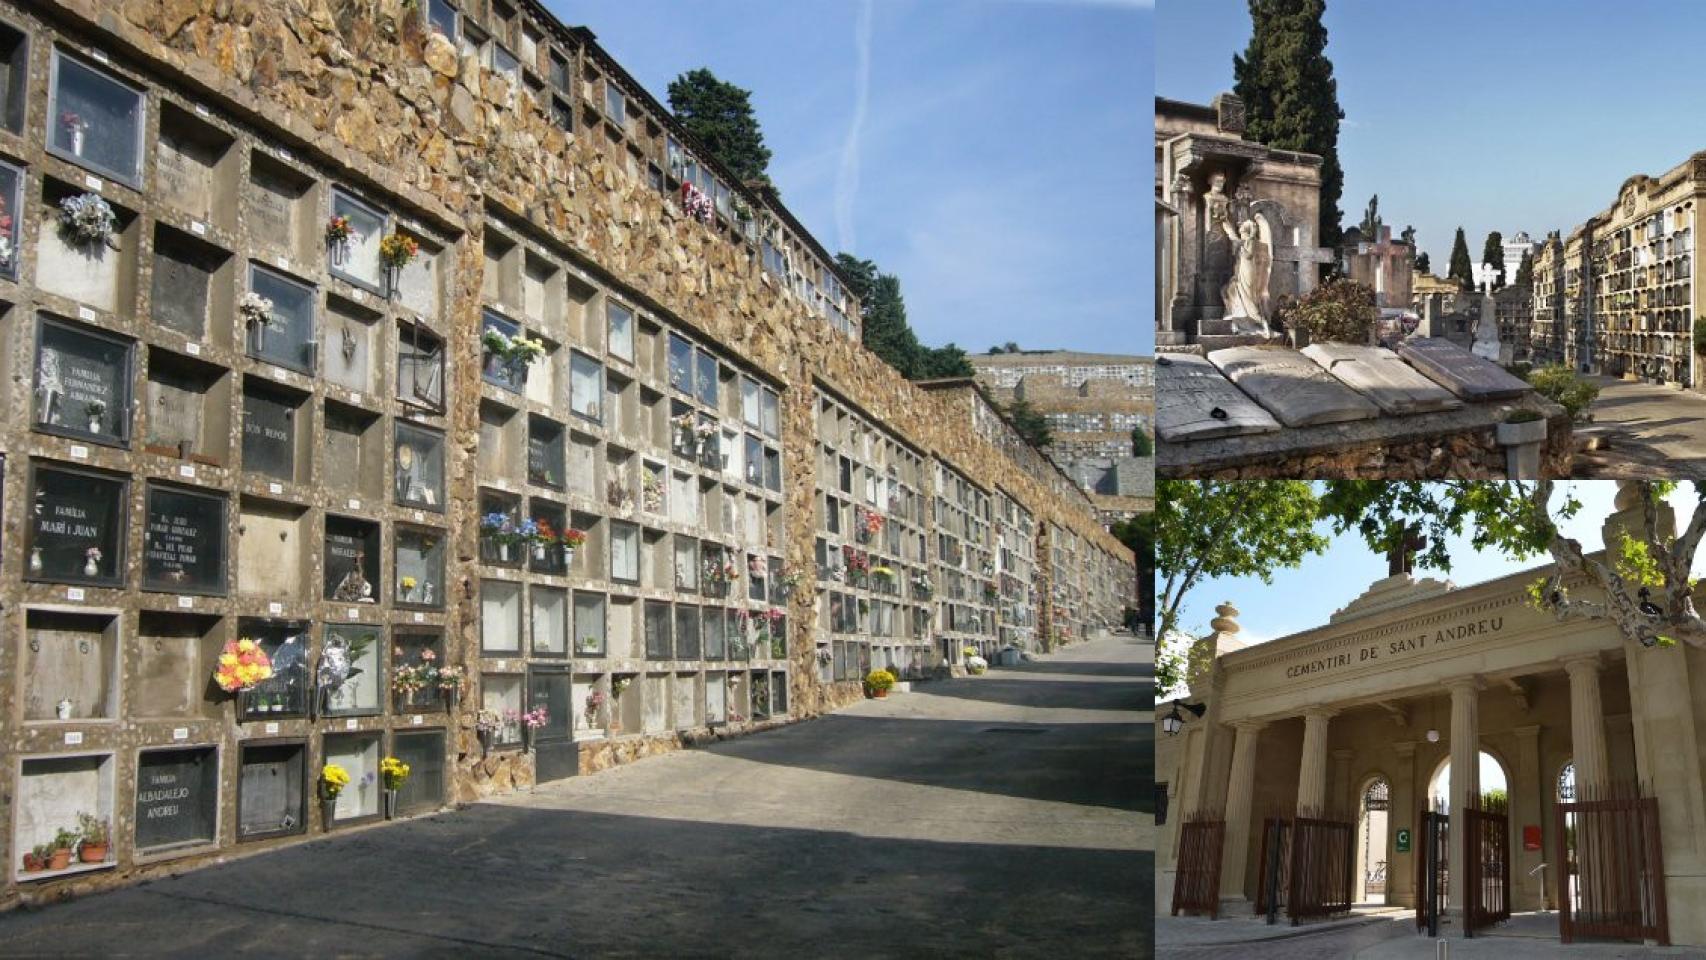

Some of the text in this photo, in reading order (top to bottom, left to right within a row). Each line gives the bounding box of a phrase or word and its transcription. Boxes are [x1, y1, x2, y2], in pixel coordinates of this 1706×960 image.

[72, 524, 98, 537] JUAN
[1287, 616, 1504, 678] CEMENTIRI DE SANT ANDREU
[147, 804, 179, 819] ANDREU
